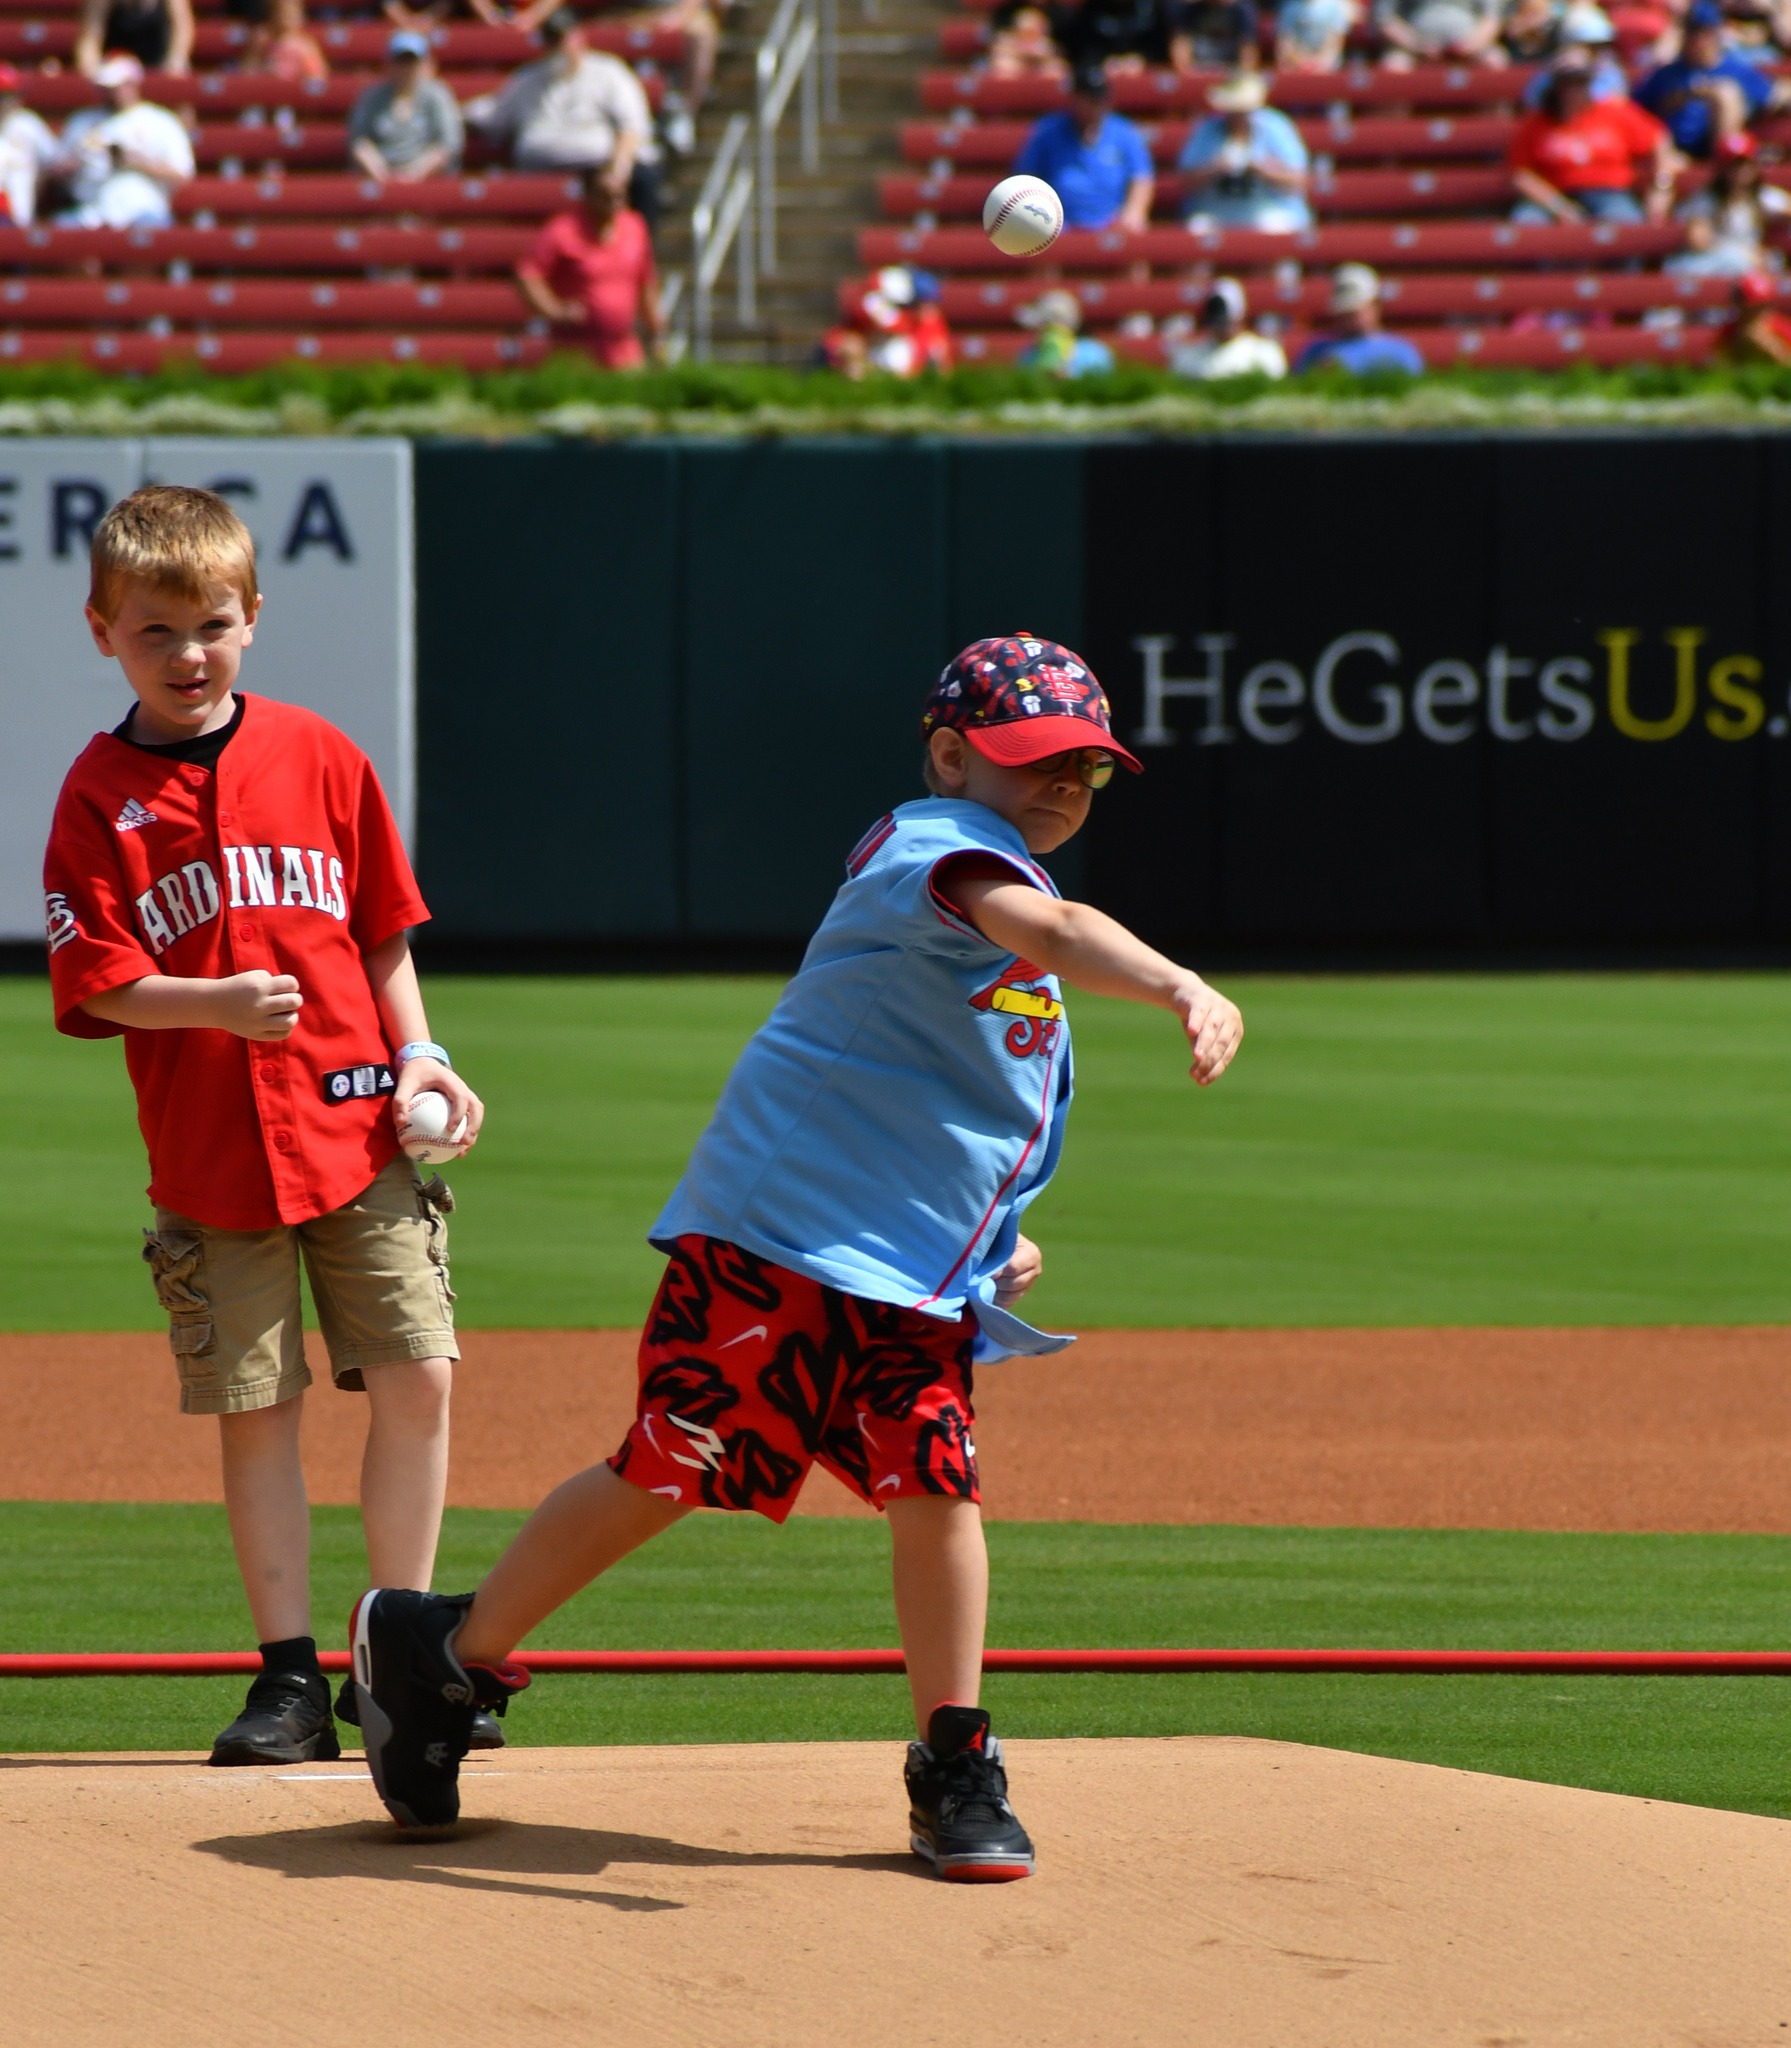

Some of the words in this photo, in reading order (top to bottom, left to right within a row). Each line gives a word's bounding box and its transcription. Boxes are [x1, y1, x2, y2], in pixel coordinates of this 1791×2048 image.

[1132, 626, 1791, 745] HeGetsUs.
[115, 811, 158, 832] adidas
[134, 844, 347, 956] ARDINALS
